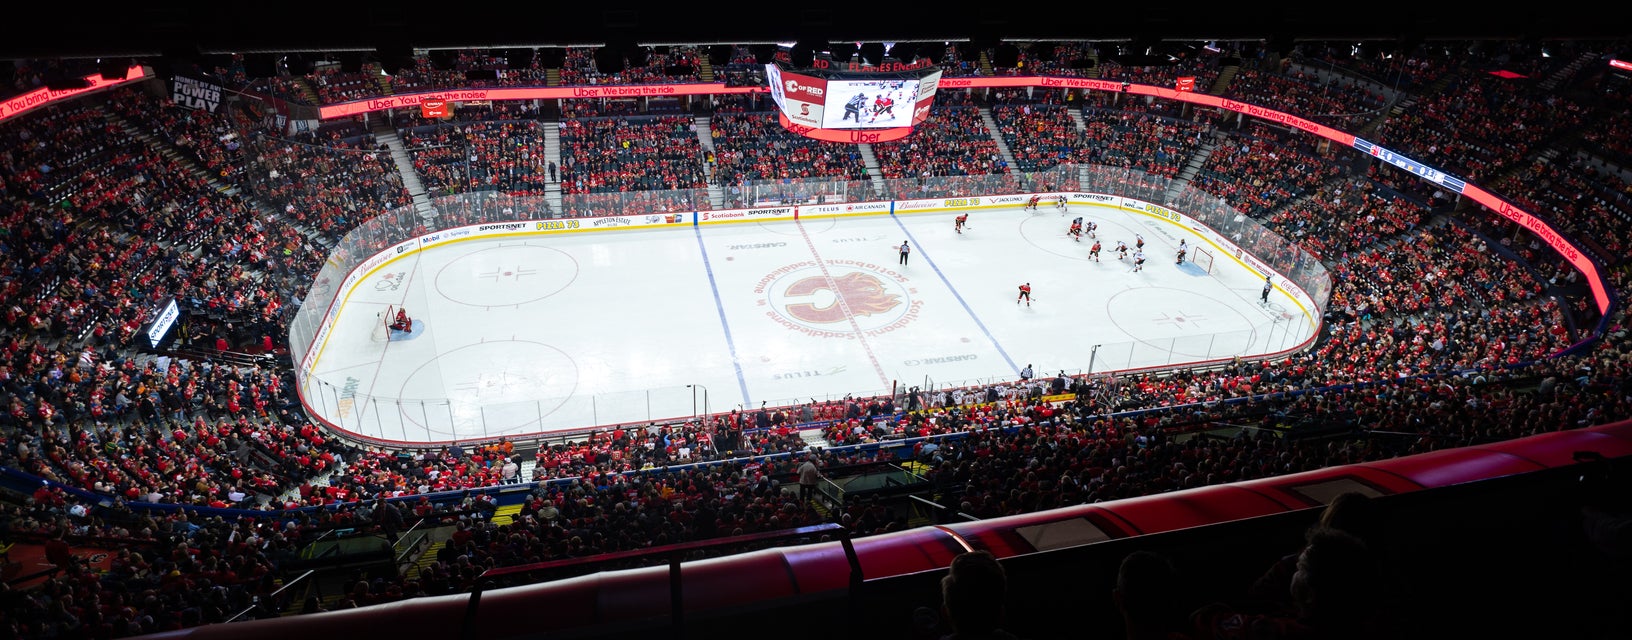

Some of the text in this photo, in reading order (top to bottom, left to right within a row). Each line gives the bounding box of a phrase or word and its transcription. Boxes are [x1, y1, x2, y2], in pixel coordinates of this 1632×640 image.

[173, 82, 221, 103] POWER
[573, 86, 675, 97] Uber We bring the ride
[806, 85, 824, 95] RED
[951, 79, 972, 87] noise
[1041, 77, 1063, 87] Uber
[1066, 79, 1079, 87] We
[1080, 79, 1101, 90] bring
[1102, 80, 1115, 90] the
[7, 101, 26, 112] You
[25, 90, 49, 104] bring
[173, 93, 219, 113] PLAY
[367, 99, 394, 111] Uber
[398, 96, 417, 105] You
[444, 90, 460, 101] the
[460, 90, 485, 100] noise
[1221, 99, 1319, 132] Uber You bring the noise
[850, 131, 880, 143] Uber
[898, 200, 937, 210] Budweiser
[944, 198, 968, 207] PIZZA
[969, 197, 981, 206] 73
[1073, 193, 1114, 201] SPORTSNET
[711, 211, 745, 219] Scotiabank
[748, 208, 791, 216] SPORTSNET
[1145, 204, 1169, 217] PIZZA
[1170, 212, 1181, 222] 73
[423, 219, 580, 244] Mobil Synergy SPORTSNET PIZZA 73
[1500, 201, 1578, 262] Uber We bring the ride
[754, 259, 817, 294] Saddledome
[825, 258, 910, 284] Scotiabank
[765, 310, 856, 341] Saddledome
[865, 299, 924, 338] Scotiabank
[771, 369, 822, 380] TELUS
